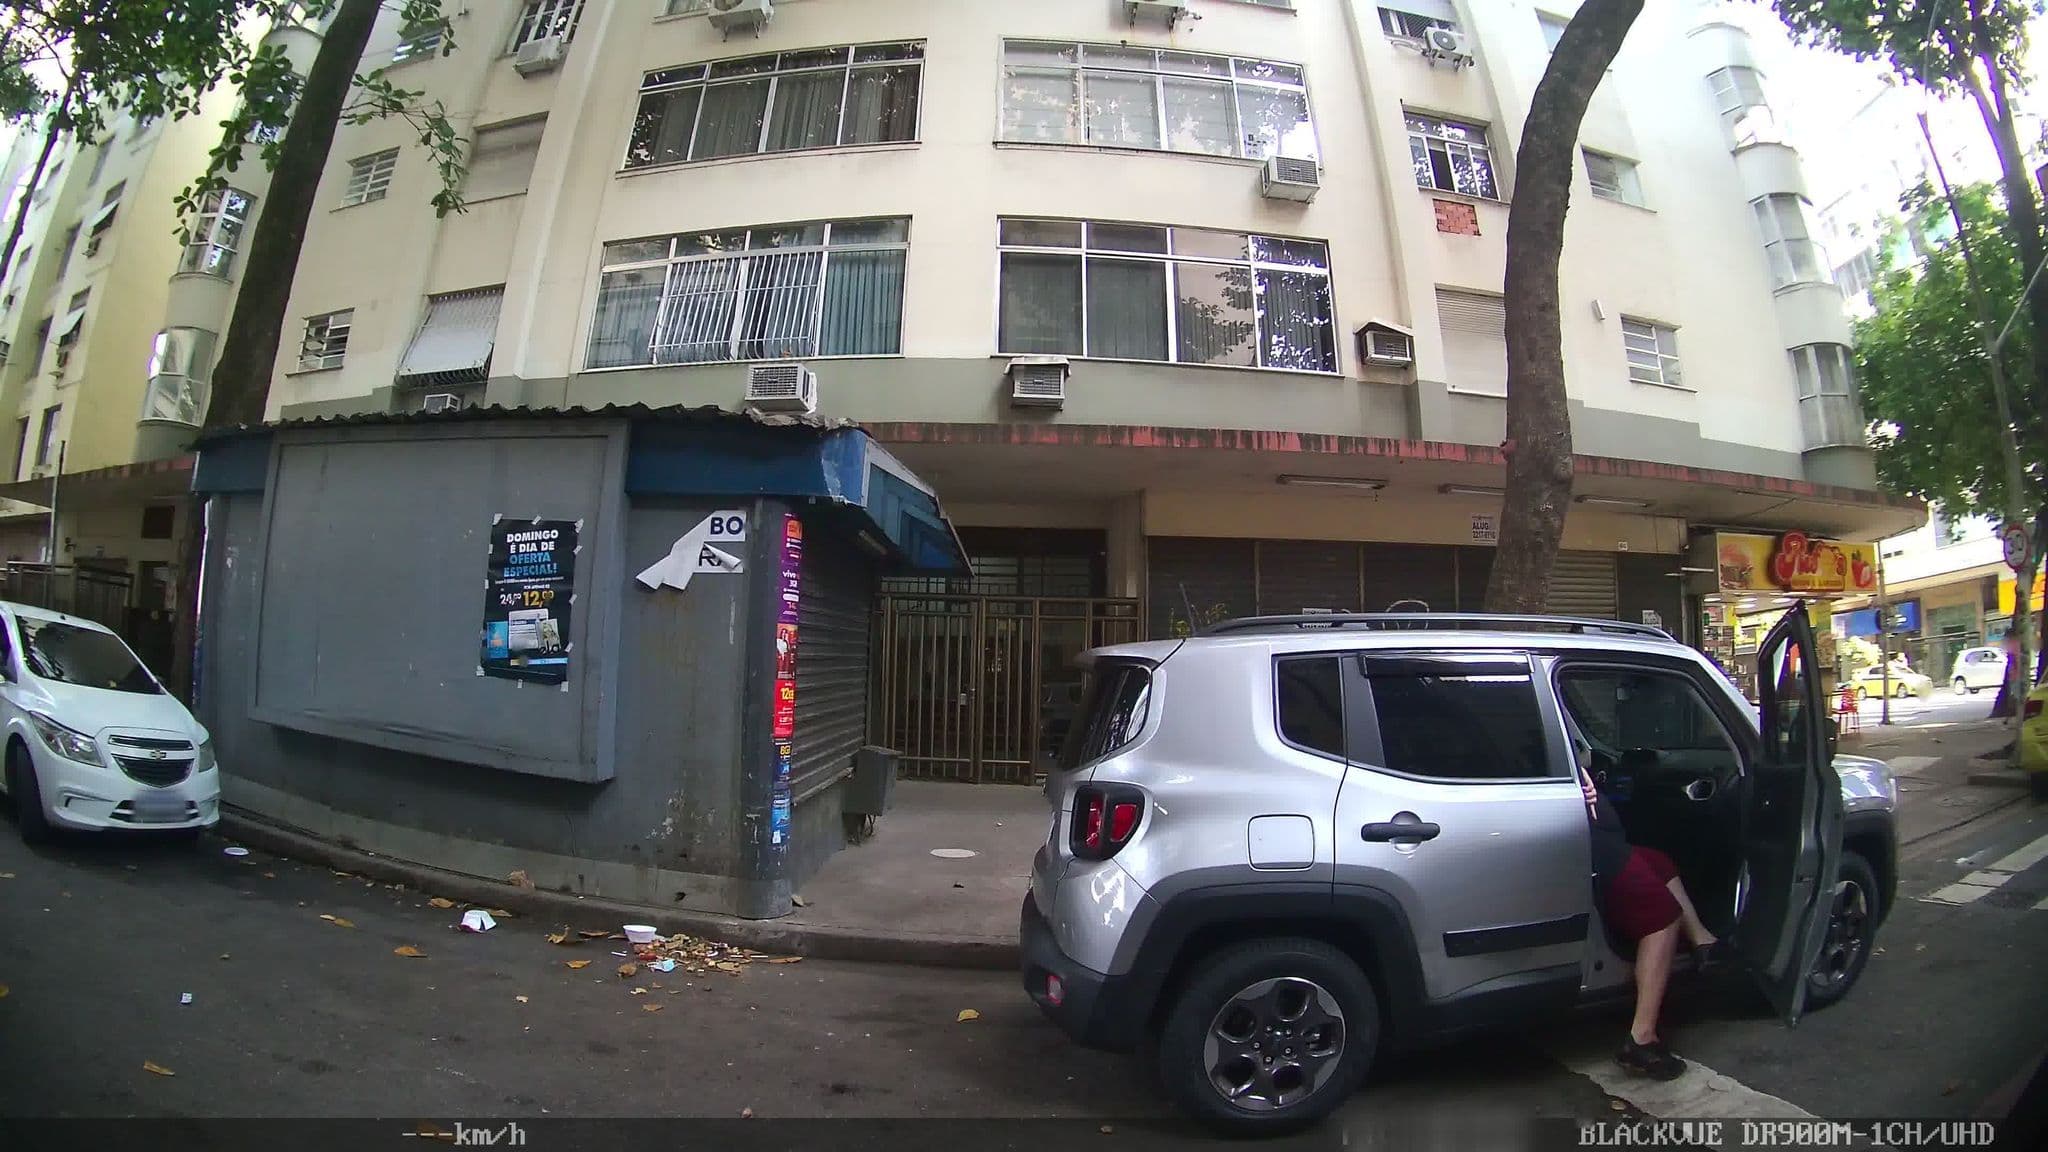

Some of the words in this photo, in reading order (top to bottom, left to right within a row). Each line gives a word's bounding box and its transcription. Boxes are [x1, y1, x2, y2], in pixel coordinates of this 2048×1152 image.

[710, 516, 744, 535] BO
[506, 529, 559, 543] DOMINGO
[510, 542, 516, 554] É
[519, 542, 538, 553] DIA
[541, 541, 555, 551] DE
[509, 552, 551, 565] OFERTA
[503, 562, 558, 578] ESPECIAL!
